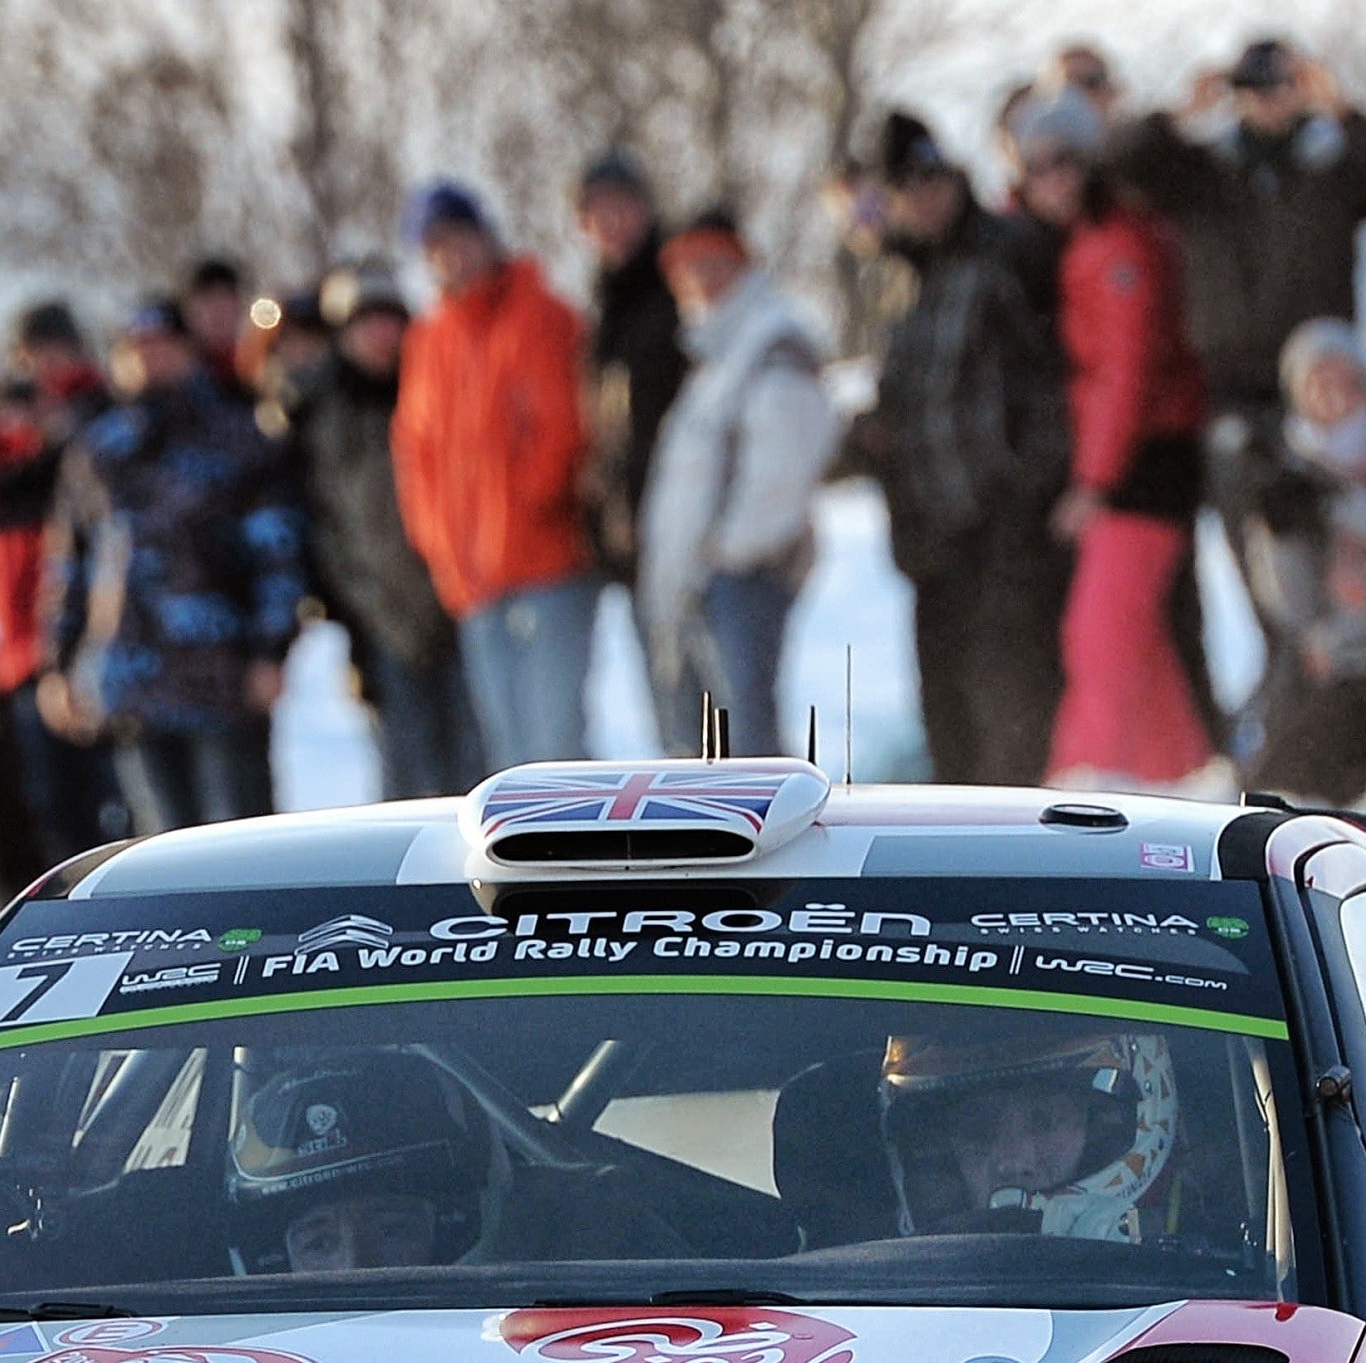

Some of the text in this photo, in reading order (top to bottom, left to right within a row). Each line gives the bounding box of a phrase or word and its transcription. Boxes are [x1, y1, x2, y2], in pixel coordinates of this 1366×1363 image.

[971, 912, 1199, 929] CERTINA
[11, 928, 212, 951] CERTINA
[261, 934, 999, 978] FIA World Rally Championship
